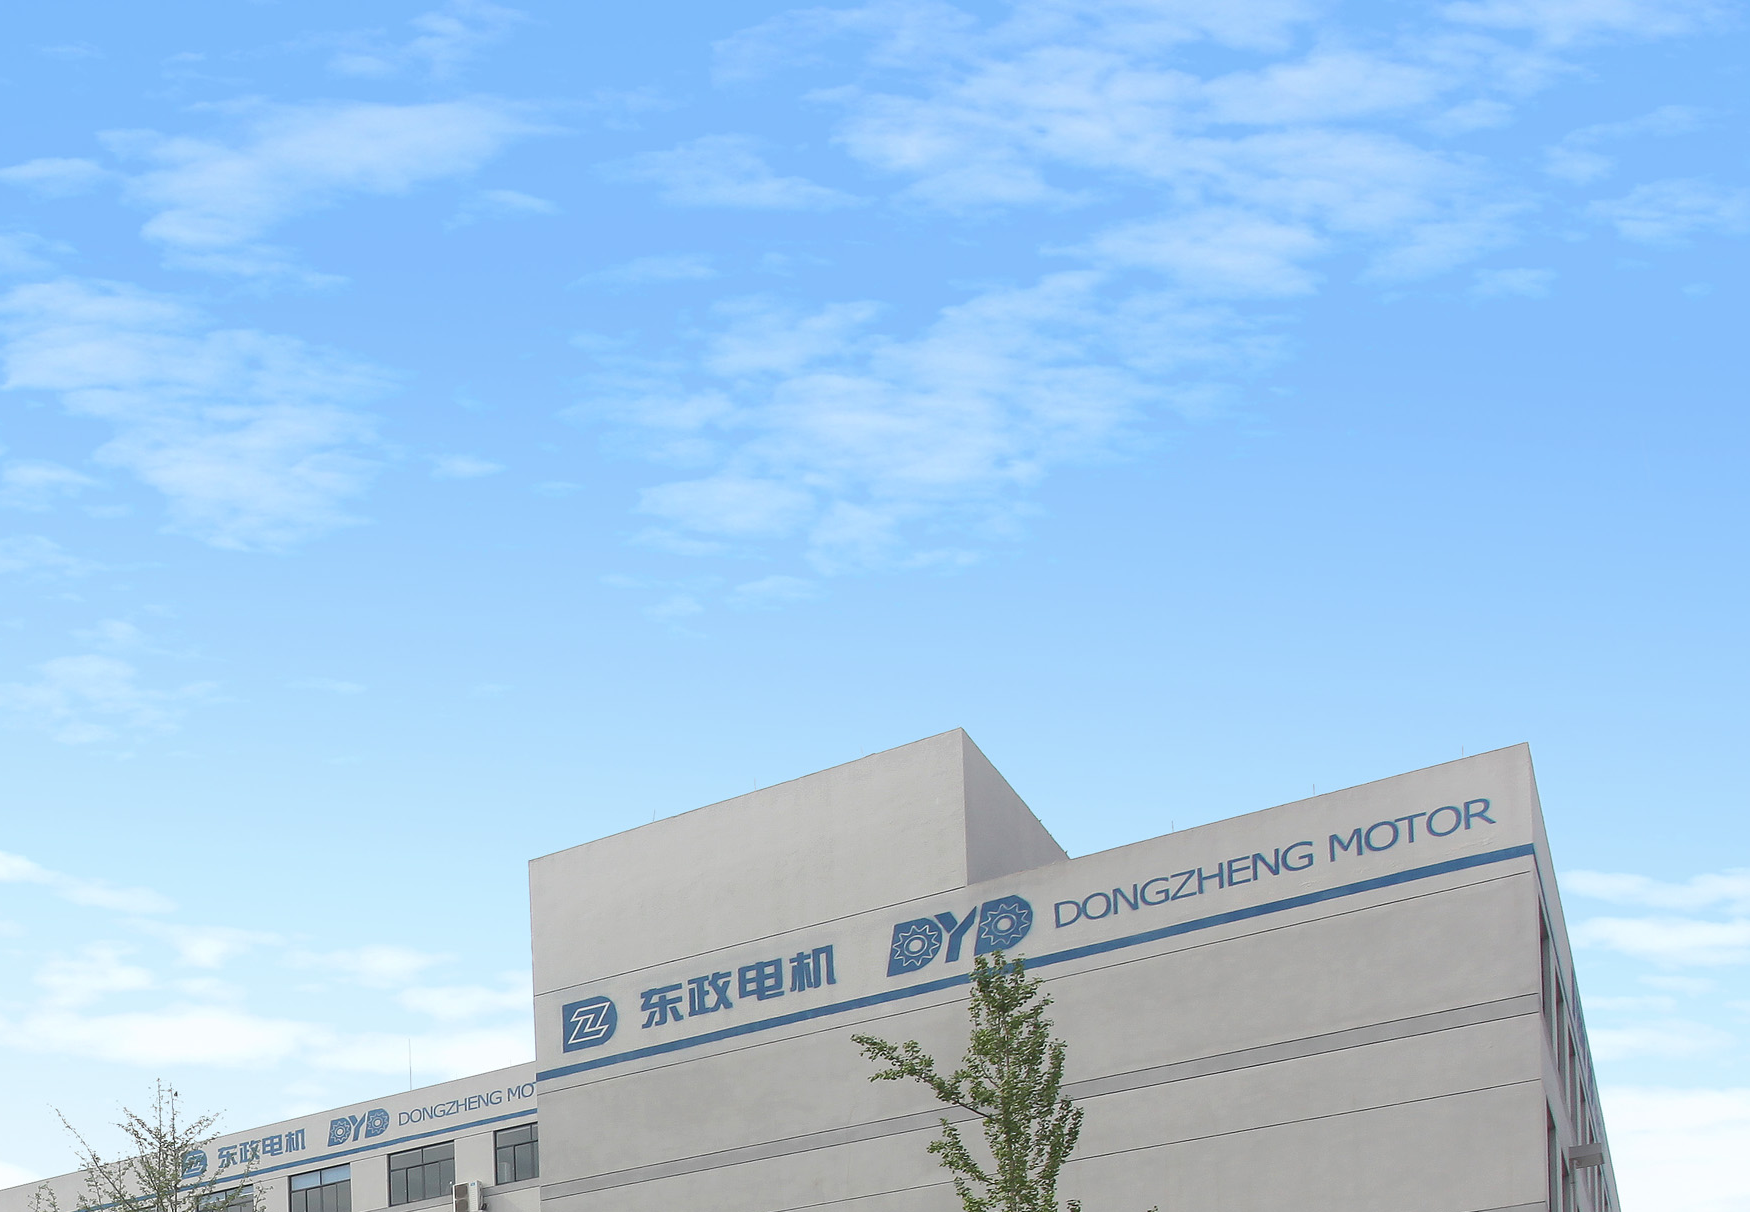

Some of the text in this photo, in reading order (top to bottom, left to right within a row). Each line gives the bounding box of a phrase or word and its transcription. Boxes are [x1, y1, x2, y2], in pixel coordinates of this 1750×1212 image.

[1053, 798, 1497, 930] DONGZHENG MOTOR
[887, 894, 1033, 978] DYD
[640, 944, 836, 1029] 东政电机
[327, 1108, 390, 1147] DYD
[398, 1082, 536, 1126] DONGZHENG MO
[217, 1129, 306, 1168] 东政电机
